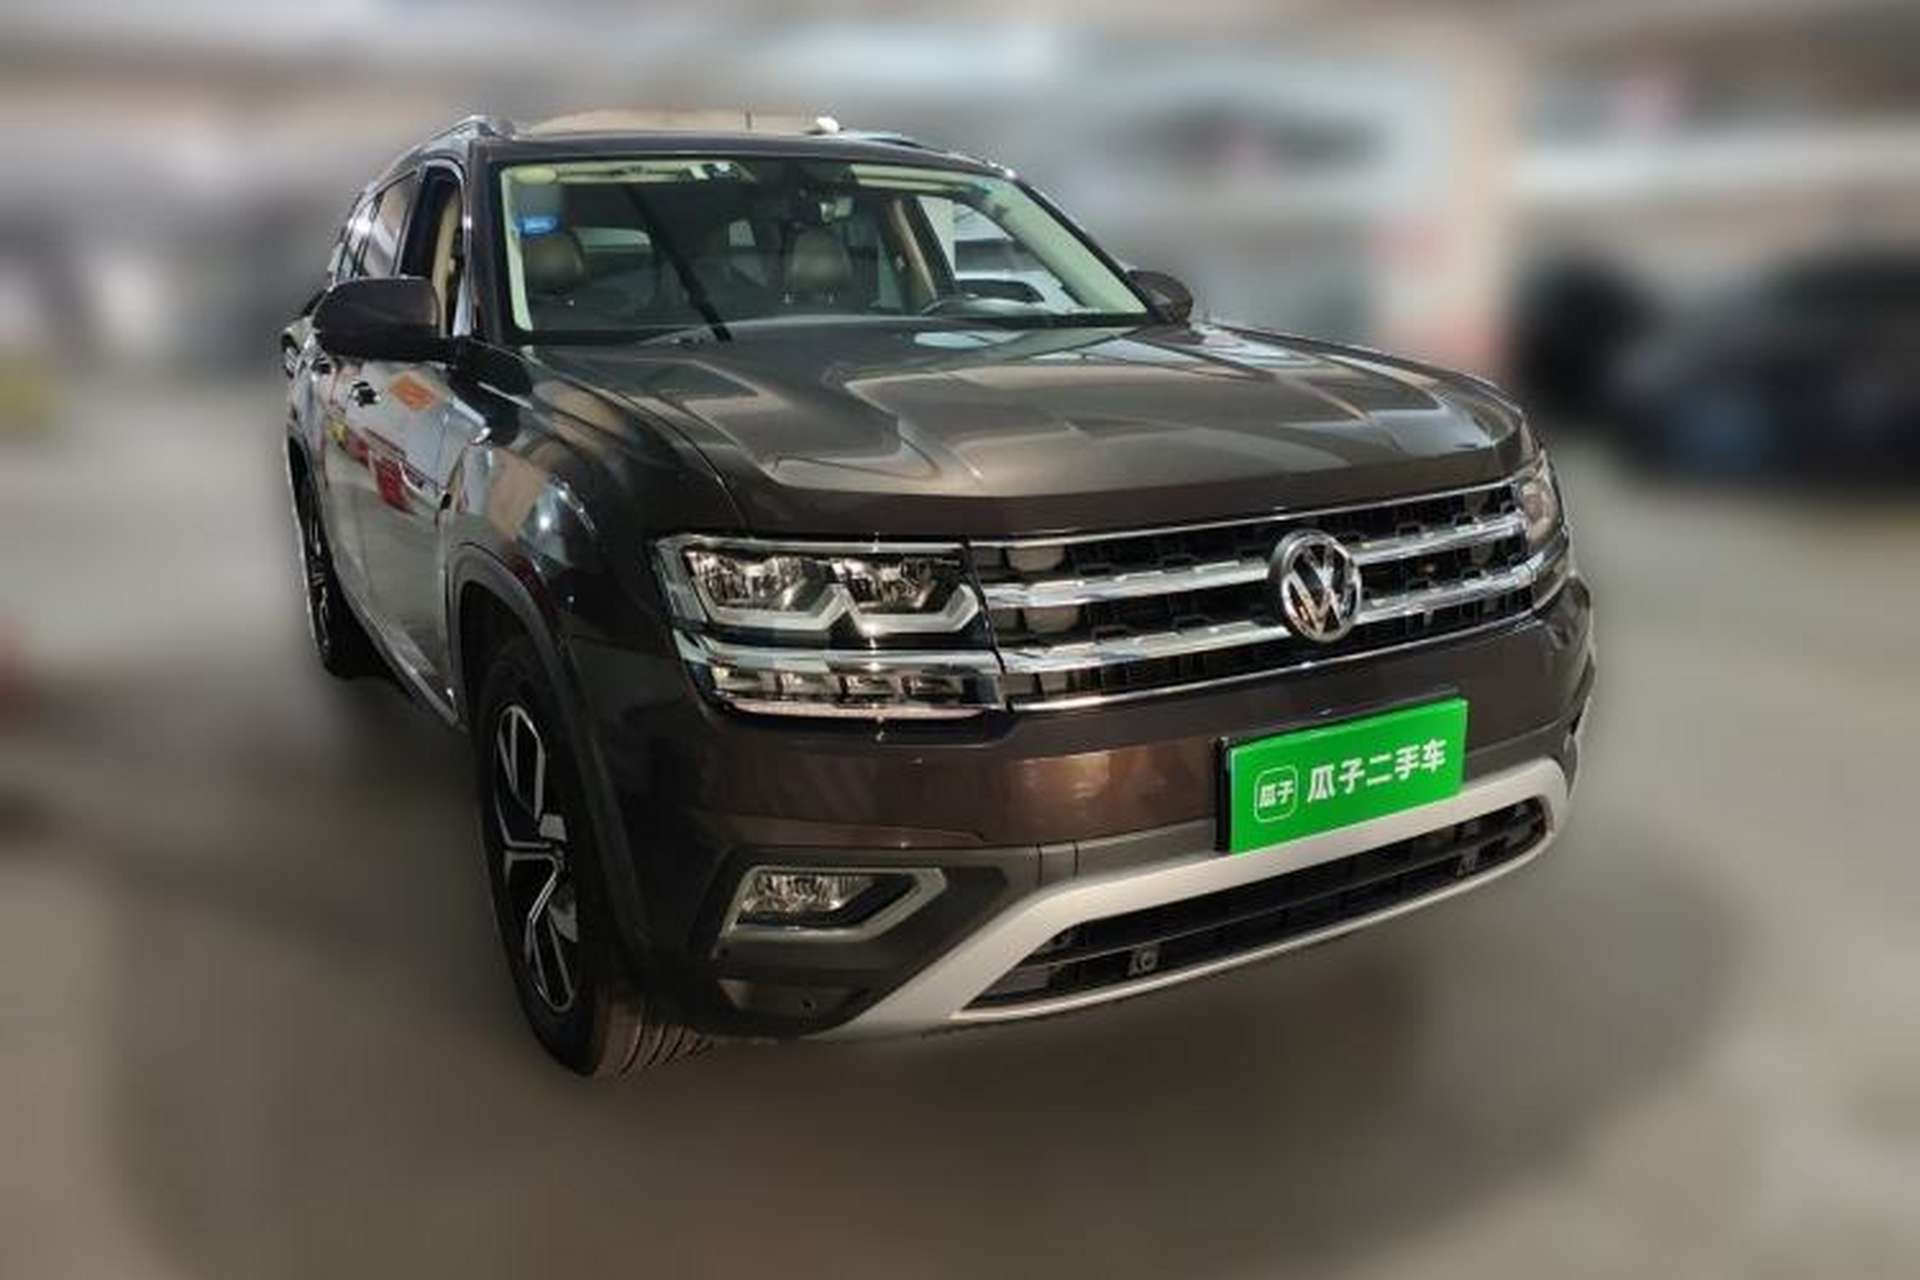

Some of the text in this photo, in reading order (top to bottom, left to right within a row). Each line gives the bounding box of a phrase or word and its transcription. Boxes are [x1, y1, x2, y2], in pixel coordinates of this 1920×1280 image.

[1308, 739, 1446, 802] 瓜子二手车
[1258, 780, 1294, 808] 瓜子
